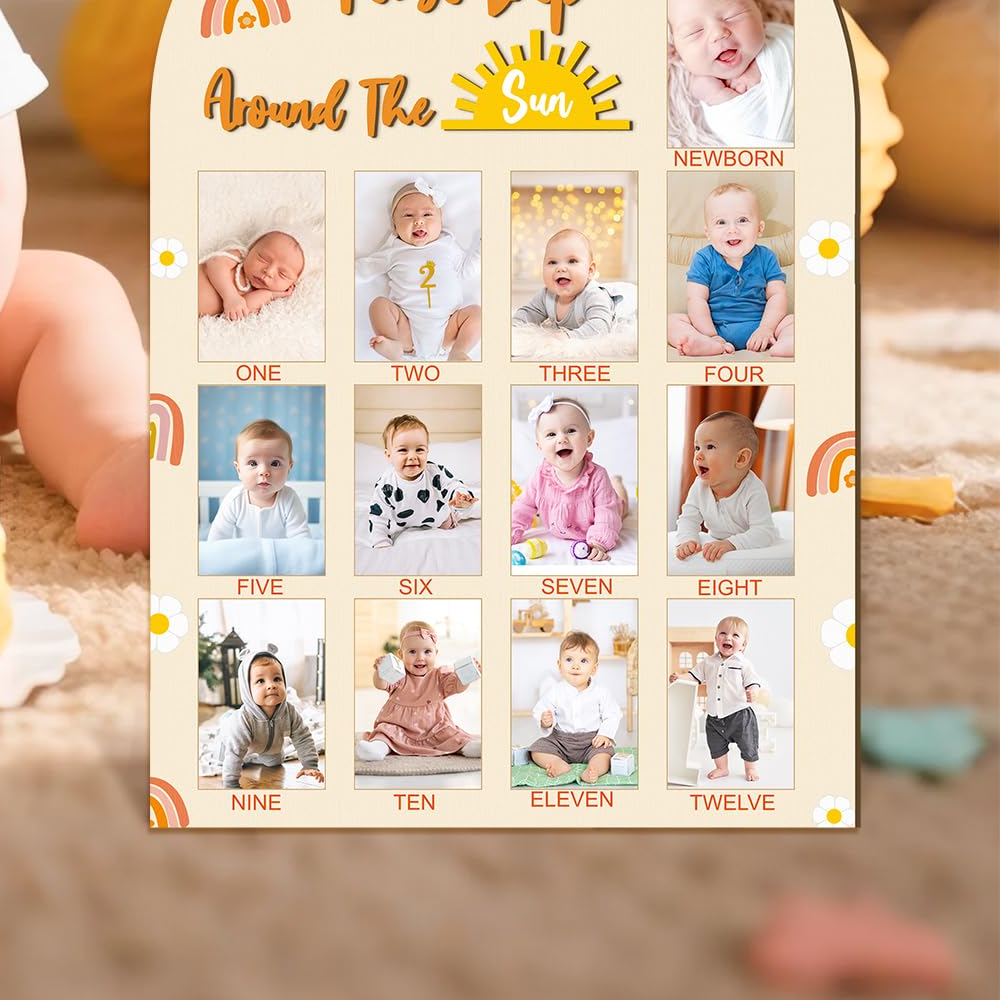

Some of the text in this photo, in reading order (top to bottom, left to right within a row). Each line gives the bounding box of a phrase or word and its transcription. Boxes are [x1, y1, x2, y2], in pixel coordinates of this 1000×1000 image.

[204, 66, 574, 138] Around The Sun
[673, 149, 784, 168] NEWBORN
[235, 364, 281, 382] ONE
[391, 364, 441, 383] TWO
[538, 364, 611, 383] THREE
[704, 365, 764, 383] FOUR
[237, 578, 284, 596] FIVE
[398, 577, 433, 596] SIX
[541, 577, 613, 595] SEVEN
[697, 578, 762, 597] EIGHT
[231, 793, 282, 811] NINE
[393, 793, 436, 811] TEN
[530, 790, 614, 808] ELEVEN
[689, 793, 776, 812] TWELVE
